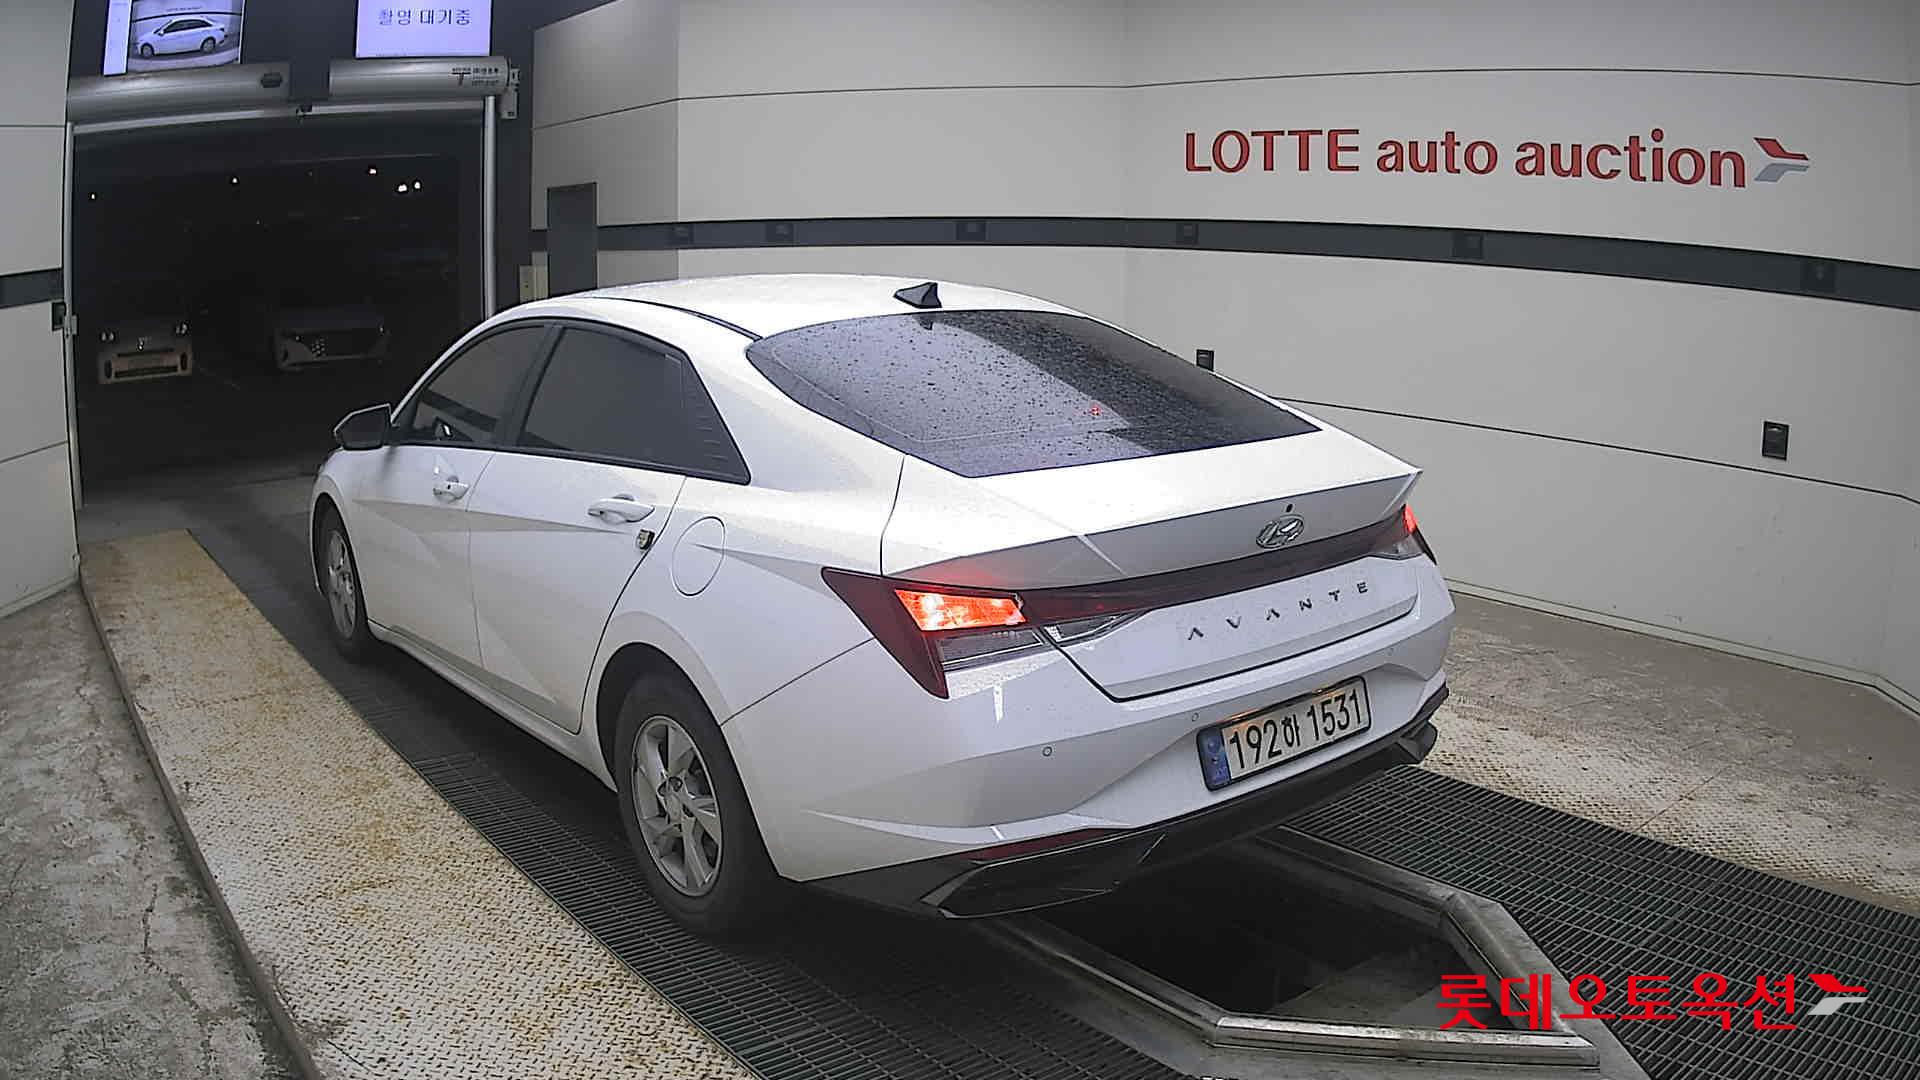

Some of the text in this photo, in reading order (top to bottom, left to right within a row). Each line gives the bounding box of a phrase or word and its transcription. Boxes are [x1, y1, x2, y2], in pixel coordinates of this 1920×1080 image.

[419, 8, 471, 26] 대기중
[1185, 128, 1747, 189] LOTTE auto auction
[1187, 581, 1369, 641] AVANTE
[1229, 688, 1362, 770] 192하 1531
